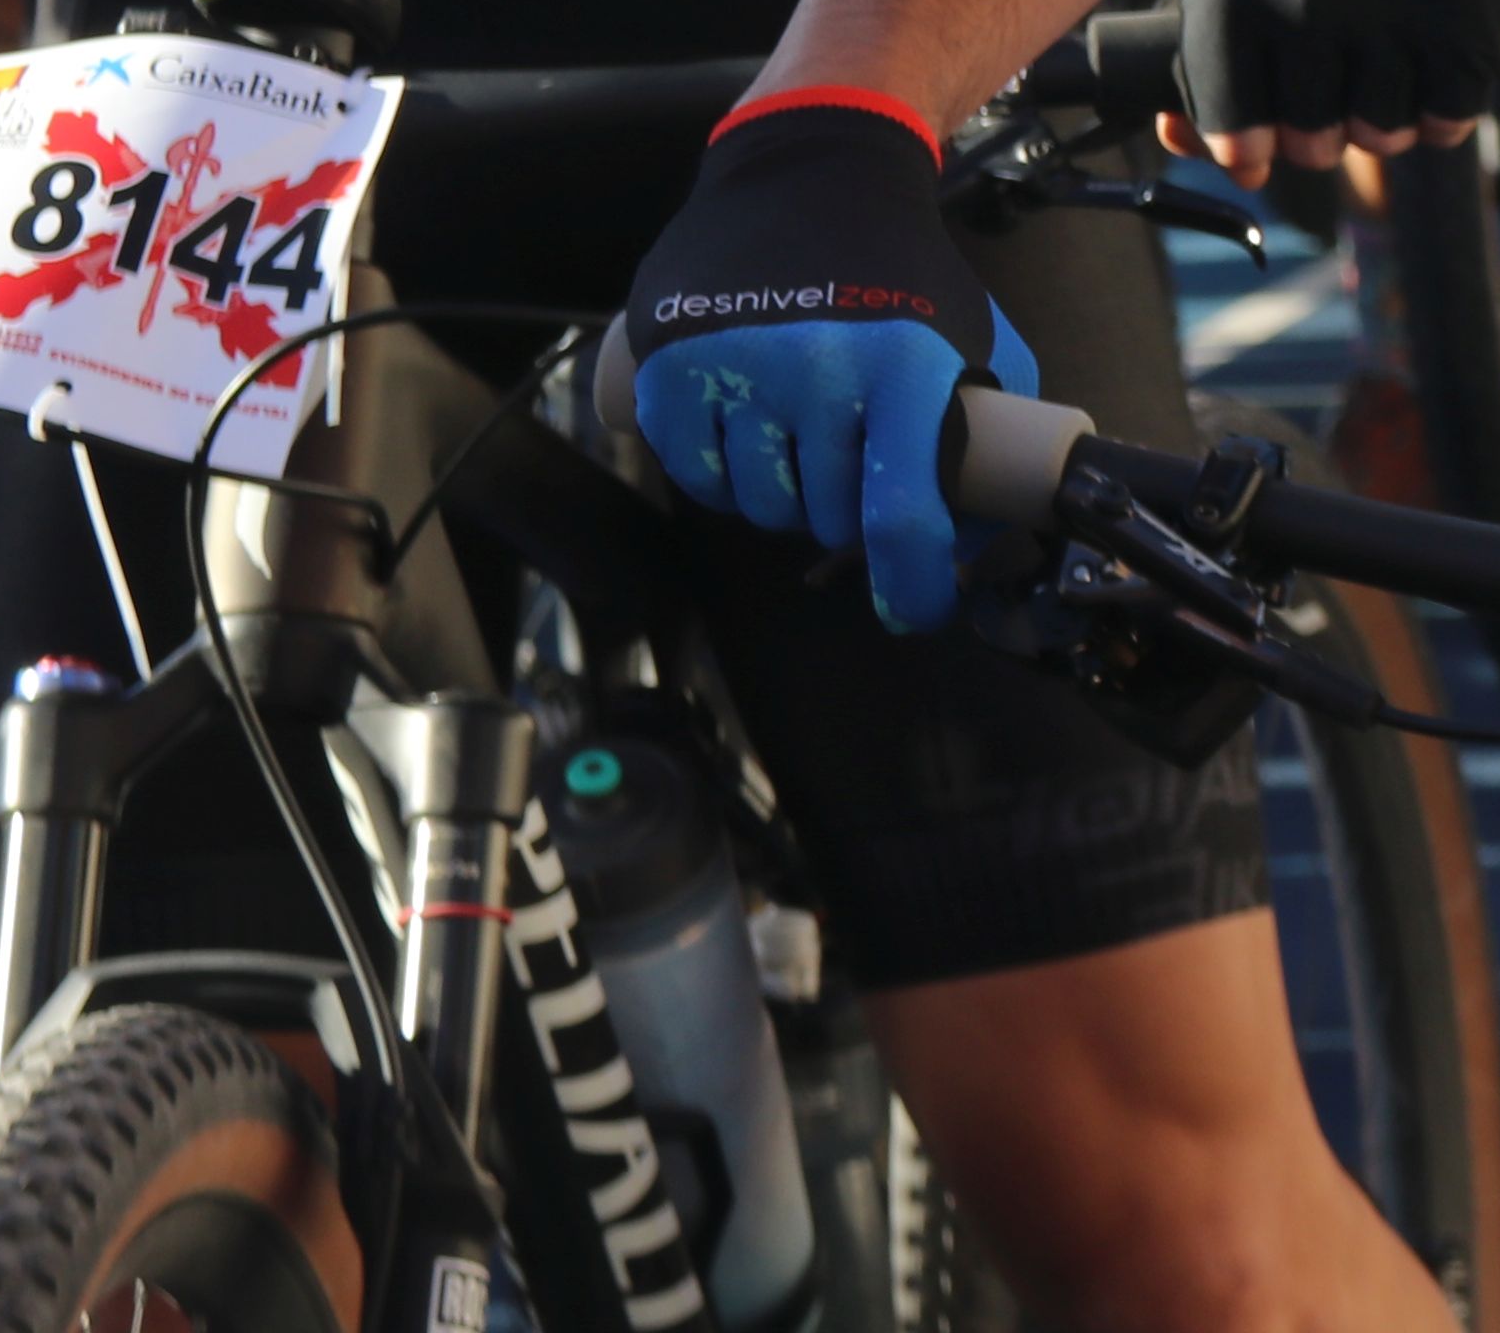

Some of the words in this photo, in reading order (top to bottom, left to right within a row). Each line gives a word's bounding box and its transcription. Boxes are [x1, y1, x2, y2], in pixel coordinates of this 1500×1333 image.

[148, 54, 332, 121] CaixaBank
[10, 160, 333, 312] 8144
[653, 280, 937, 325] desnivelzero
